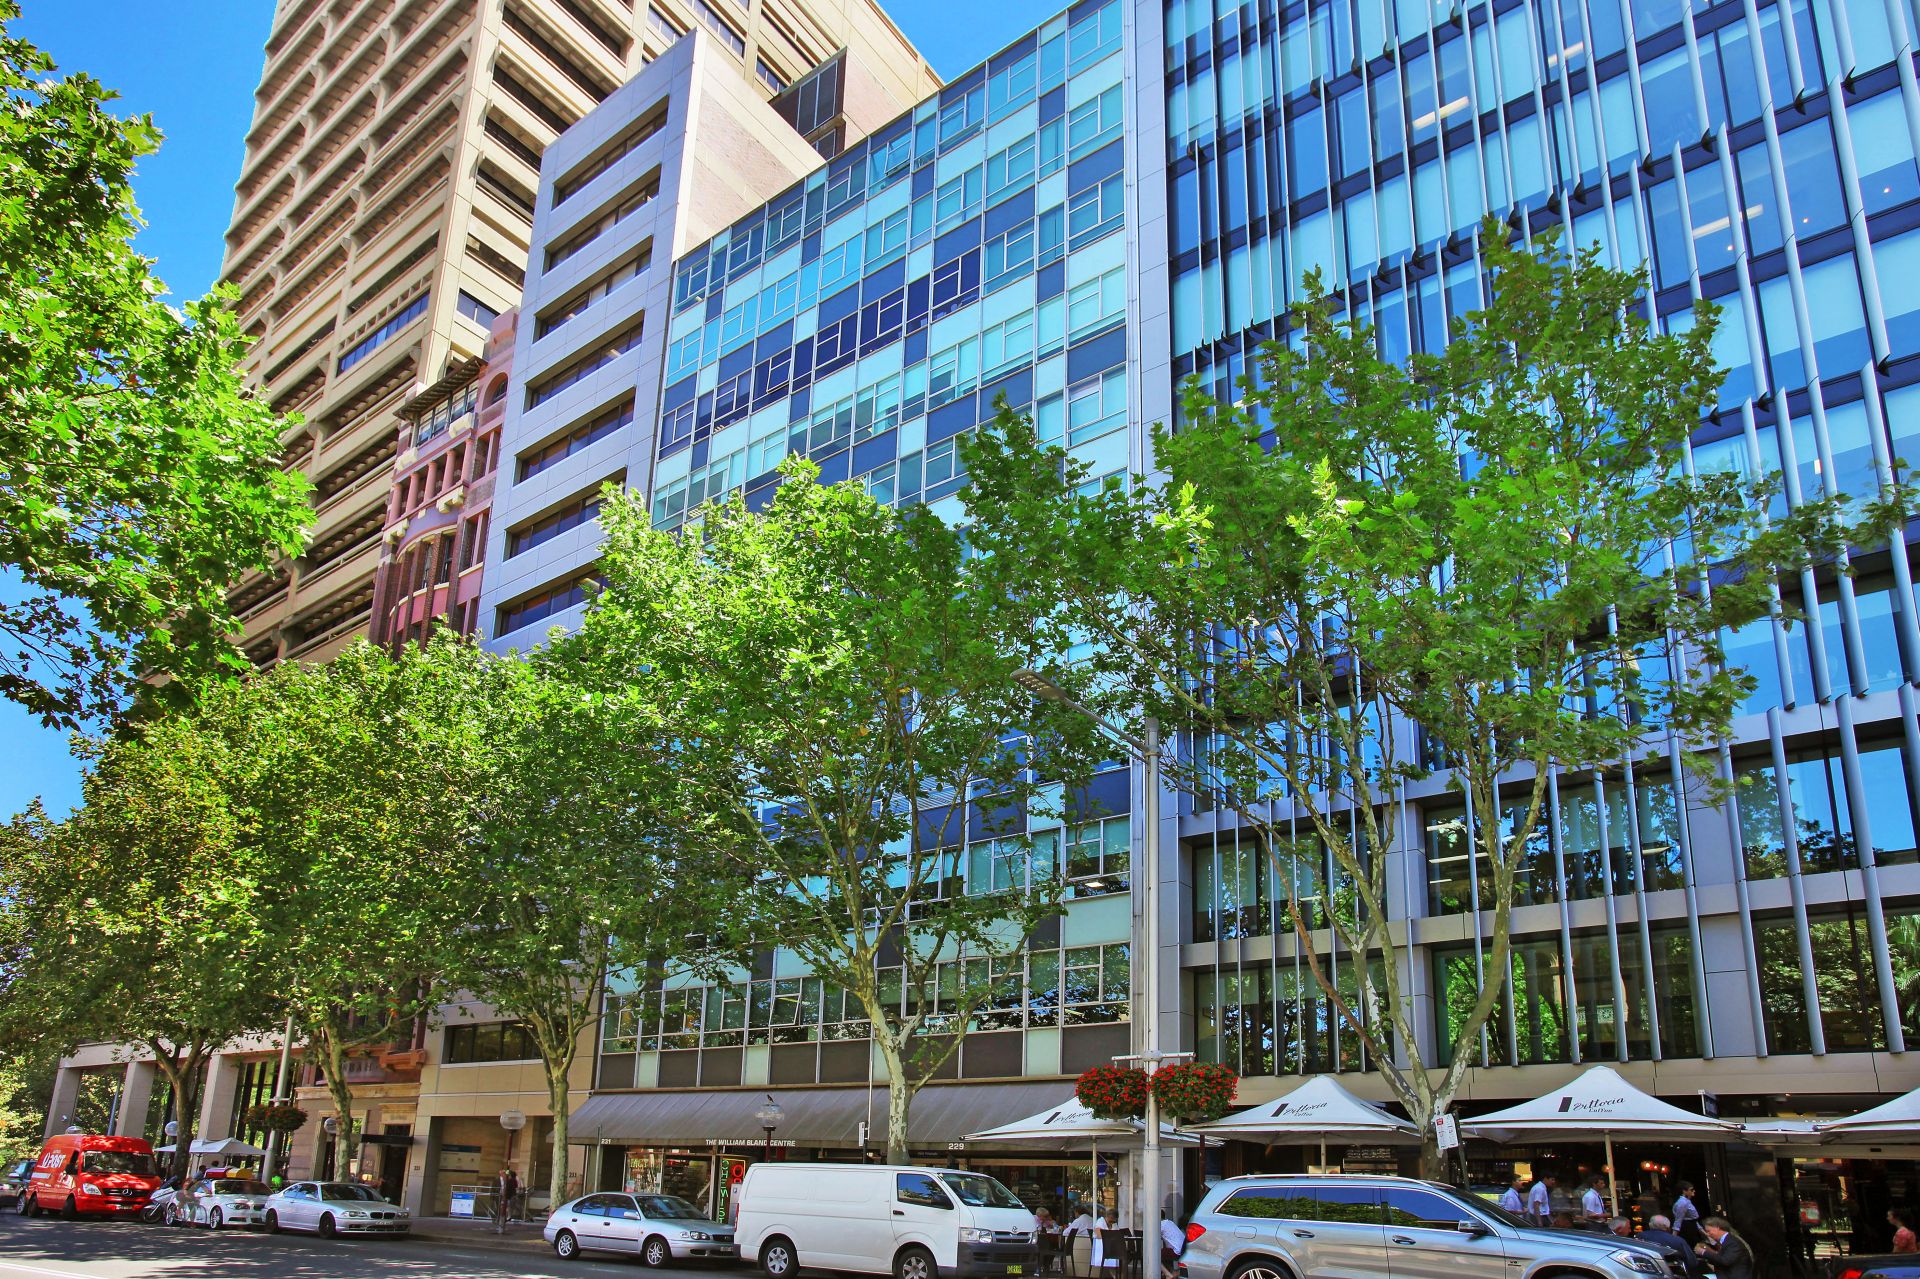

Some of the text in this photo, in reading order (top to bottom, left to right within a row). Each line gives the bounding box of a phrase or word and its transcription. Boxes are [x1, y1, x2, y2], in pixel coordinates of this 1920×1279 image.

[746, 1139, 767, 1147] BLAND
[948, 1142, 965, 1150] 229
[50, 1154, 66, 1168] POST
[719, 1160, 729, 1224] CHEMIST
